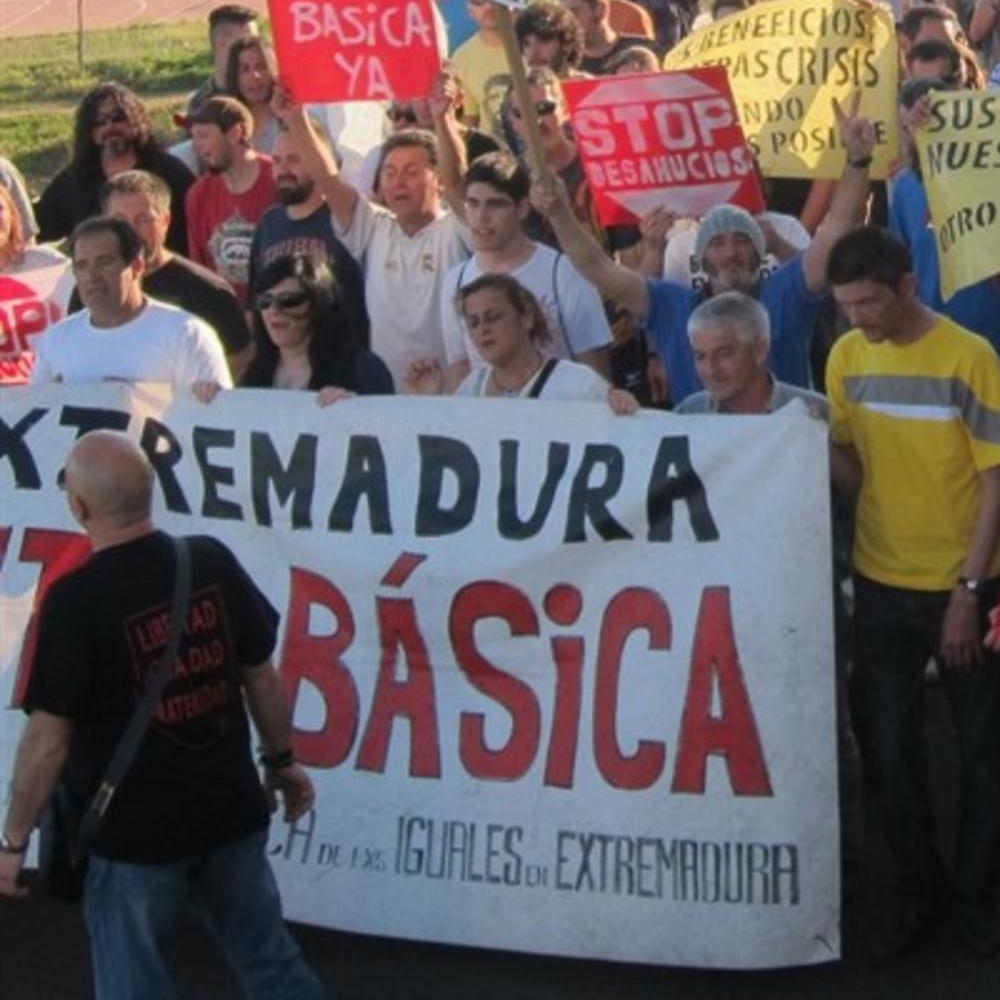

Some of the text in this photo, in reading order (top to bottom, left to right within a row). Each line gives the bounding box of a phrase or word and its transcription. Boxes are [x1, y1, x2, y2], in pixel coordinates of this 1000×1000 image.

[333, 52, 395, 100] YA
[776, 46, 880, 88] CRISIS
[574, 96, 734, 157] STOP
[742, 97, 804, 124] NDO
[929, 97, 997, 133] SUS
[771, 119, 889, 154] POSIE
[395, 815, 524, 886] IGUALES
[555, 829, 799, 906] EXTREMADURA
